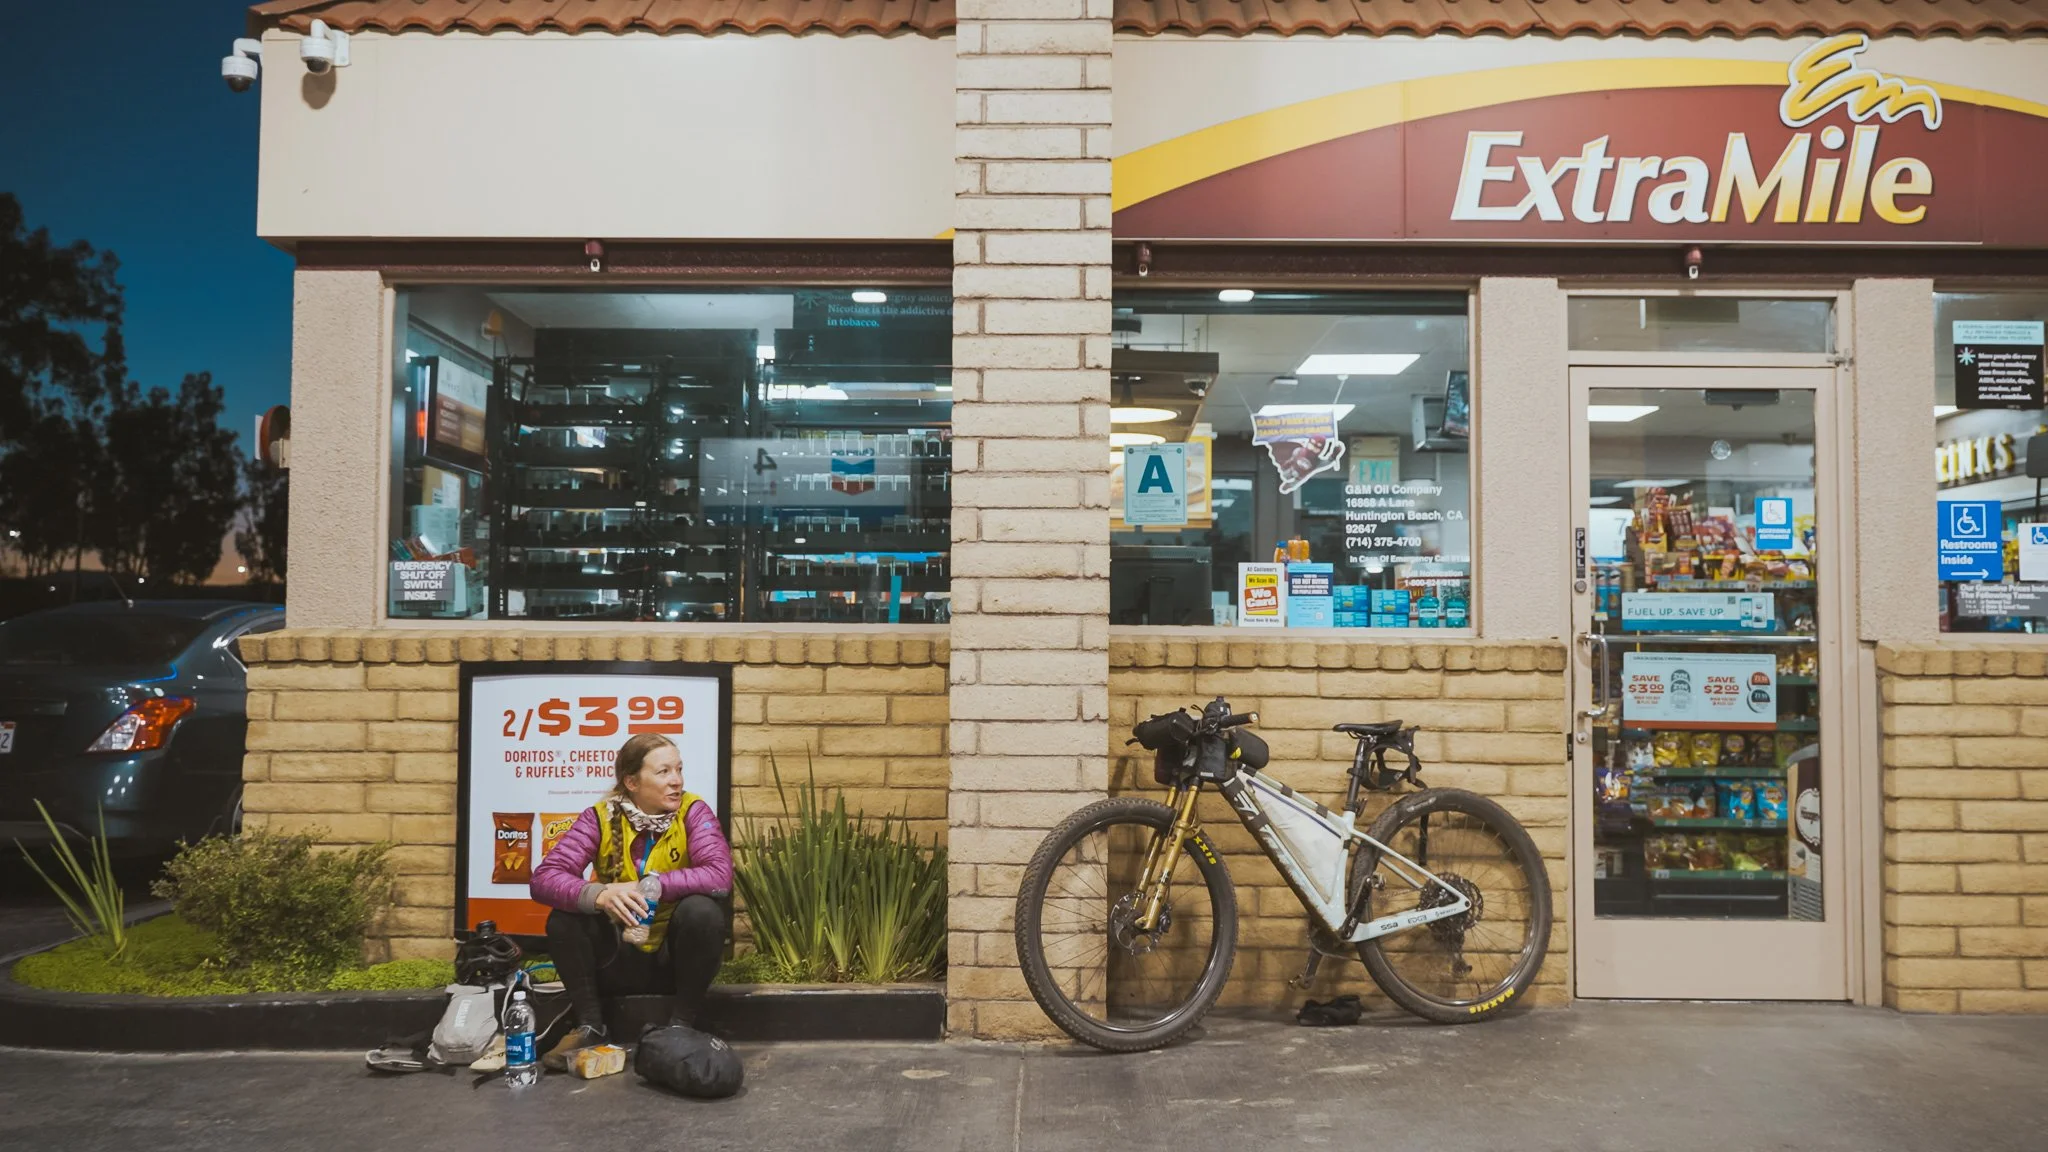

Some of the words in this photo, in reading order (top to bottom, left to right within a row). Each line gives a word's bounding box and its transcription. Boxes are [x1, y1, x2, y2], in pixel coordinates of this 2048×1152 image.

[1451, 124, 1933, 224] ExtraMile
[828, 304, 869, 315] Nicotine
[872, 304, 880, 315] is
[882, 304, 897, 315] the
[901, 305, 945, 316] addictive
[828, 318, 838, 327] in
[840, 318, 880, 327] tobacco.
[1137, 455, 1174, 493] A
[1345, 484, 1372, 495] G&M
[1374, 484, 1389, 495] Oil
[1391, 484, 1442, 496] Company
[1378, 498, 1387, 508] A
[1389, 498, 1415, 508] Lane
[1345, 510, 1405, 523] Huntington
[1407, 510, 1444, 521] Beach,
[1446, 510, 1464, 520] CA
[1345, 537, 1372, 549] (714)
[1374, 537, 1422, 547] 375-4700
[1940, 539, 1998, 550] Restrooms
[1575, 531, 1585, 567] PULL
[1940, 554, 1974, 565] Inside
[394, 561, 452, 571] EMERGENCY
[399, 570, 447, 580] SHUT-OFF
[403, 580, 443, 590] SWITCH
[404, 591, 437, 601] INSIDE
[1250, 588, 1272, 599] We
[1627, 607, 1655, 616] FUEL
[1678, 608, 1705, 616] SAVE
[515, 766, 522, 778] &
[586, 765, 617, 778] PRIC
[497, 829, 528, 840] Doritos
[1469, 986, 1515, 1014] MAXXIS
